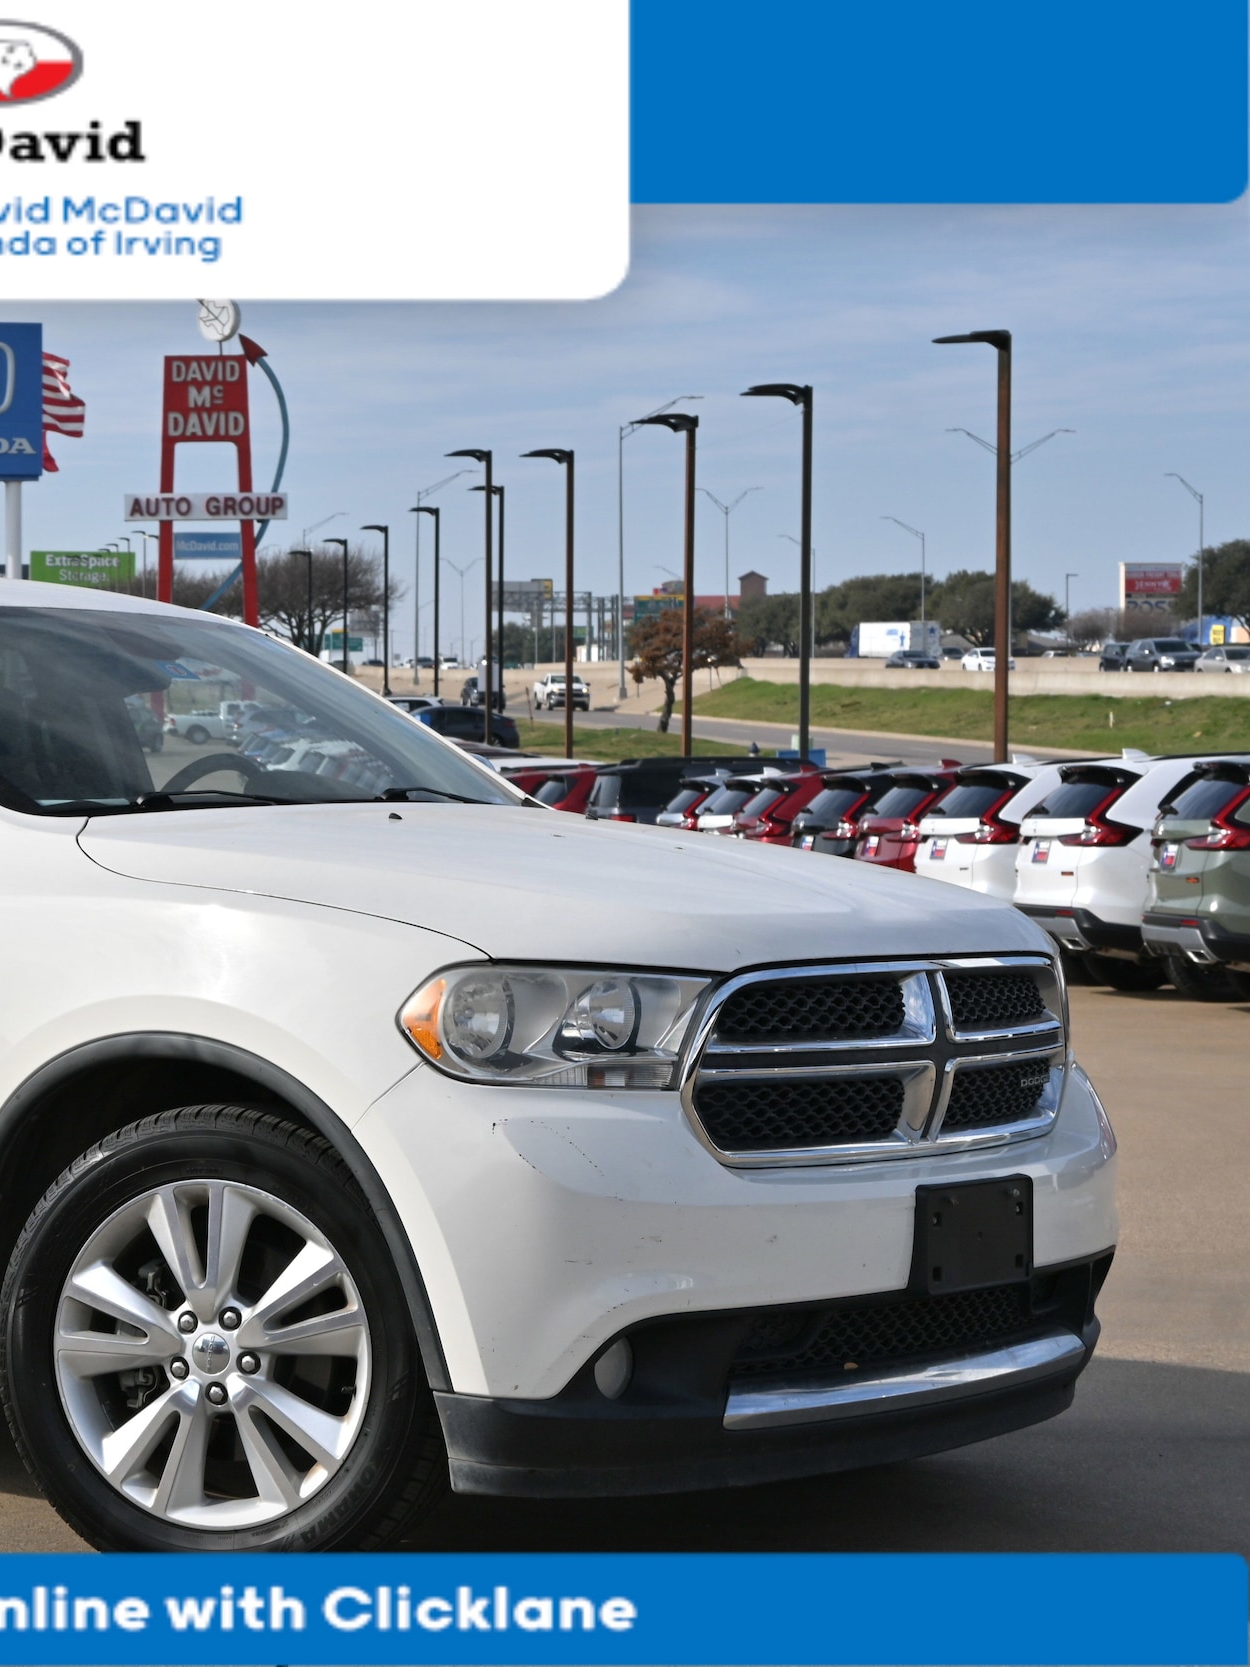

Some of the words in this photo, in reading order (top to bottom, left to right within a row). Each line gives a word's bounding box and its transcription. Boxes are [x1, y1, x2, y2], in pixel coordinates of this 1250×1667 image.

[171, 360, 240, 382] DAVID
[167, 411, 245, 436] DAVID
[130, 497, 193, 517] AUTO
[205, 496, 285, 517] GROUP
[176, 540, 239, 551] McDavid.com
